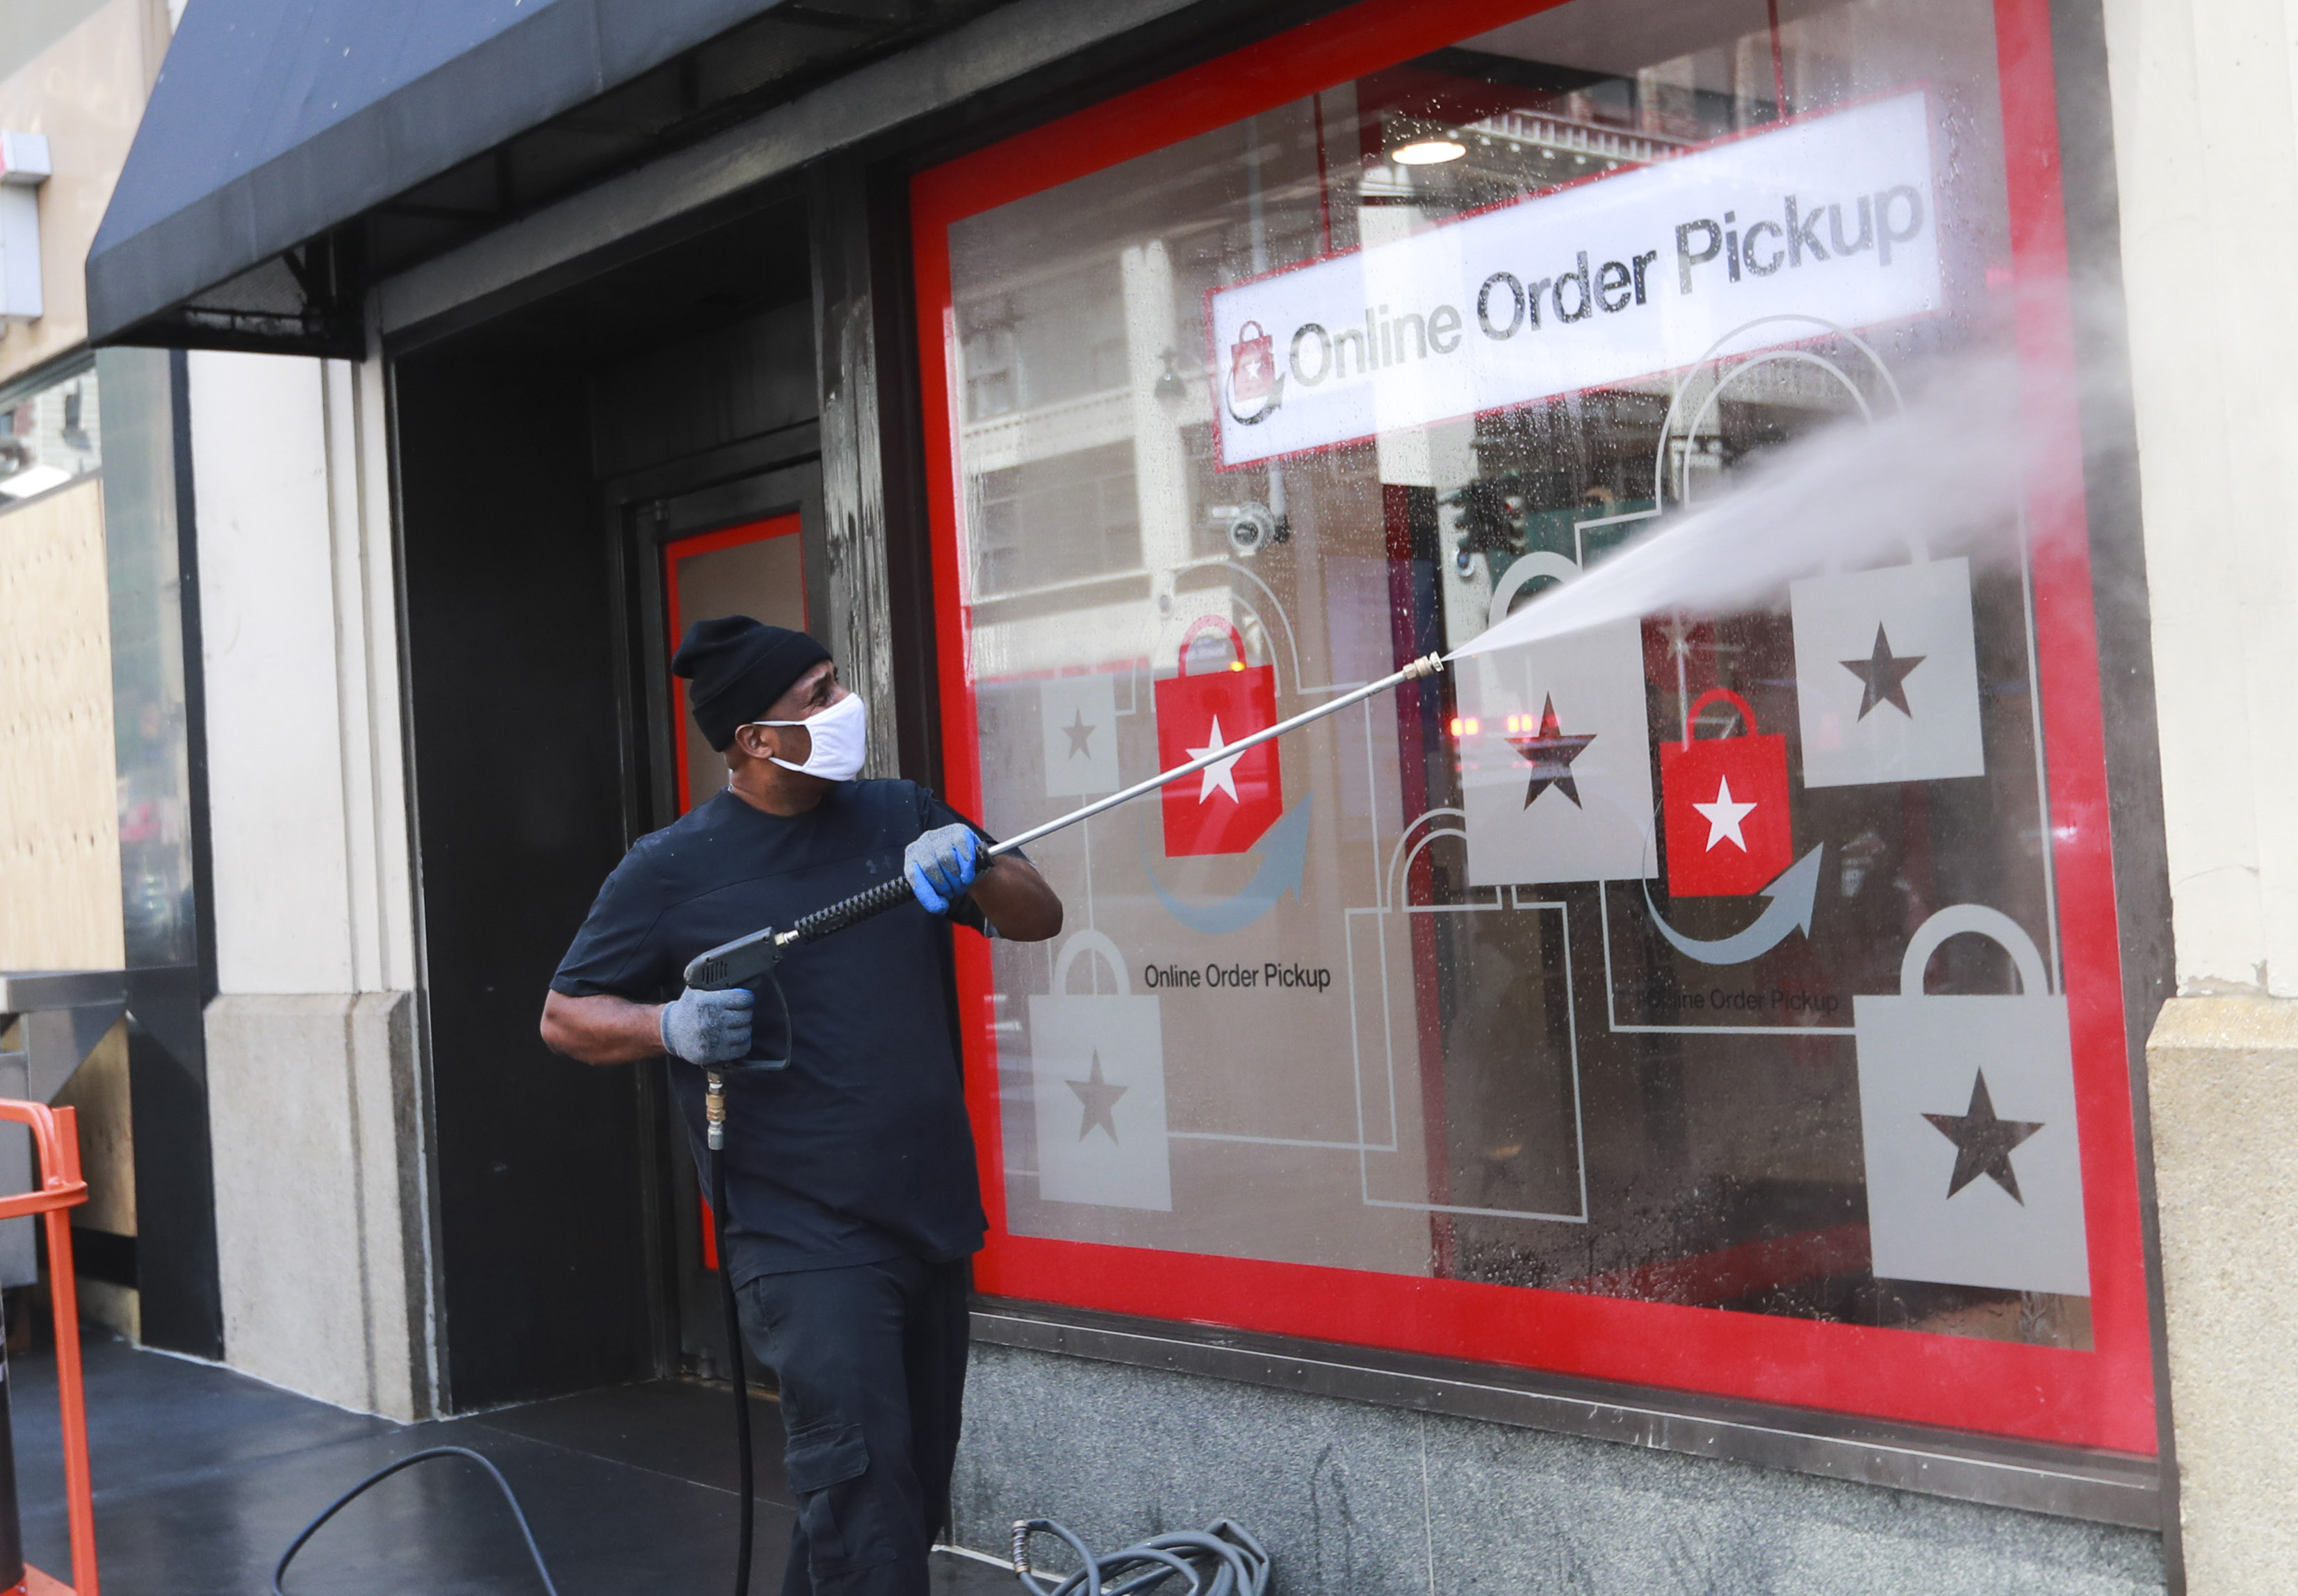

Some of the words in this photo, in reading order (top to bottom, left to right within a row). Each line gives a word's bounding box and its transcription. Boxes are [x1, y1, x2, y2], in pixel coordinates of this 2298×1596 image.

[1289, 304, 1461, 388] Online
[1476, 250, 1657, 341] Order
[1675, 184, 1924, 295] Pickup
[1145, 964, 1200, 988] Online
[1206, 963, 1259, 987] Order
[1264, 963, 1331, 992] Pickup
[1647, 987, 1705, 1009] Oline
[1710, 988, 1766, 1009] Order
[1772, 988, 1840, 1013] Pickup
